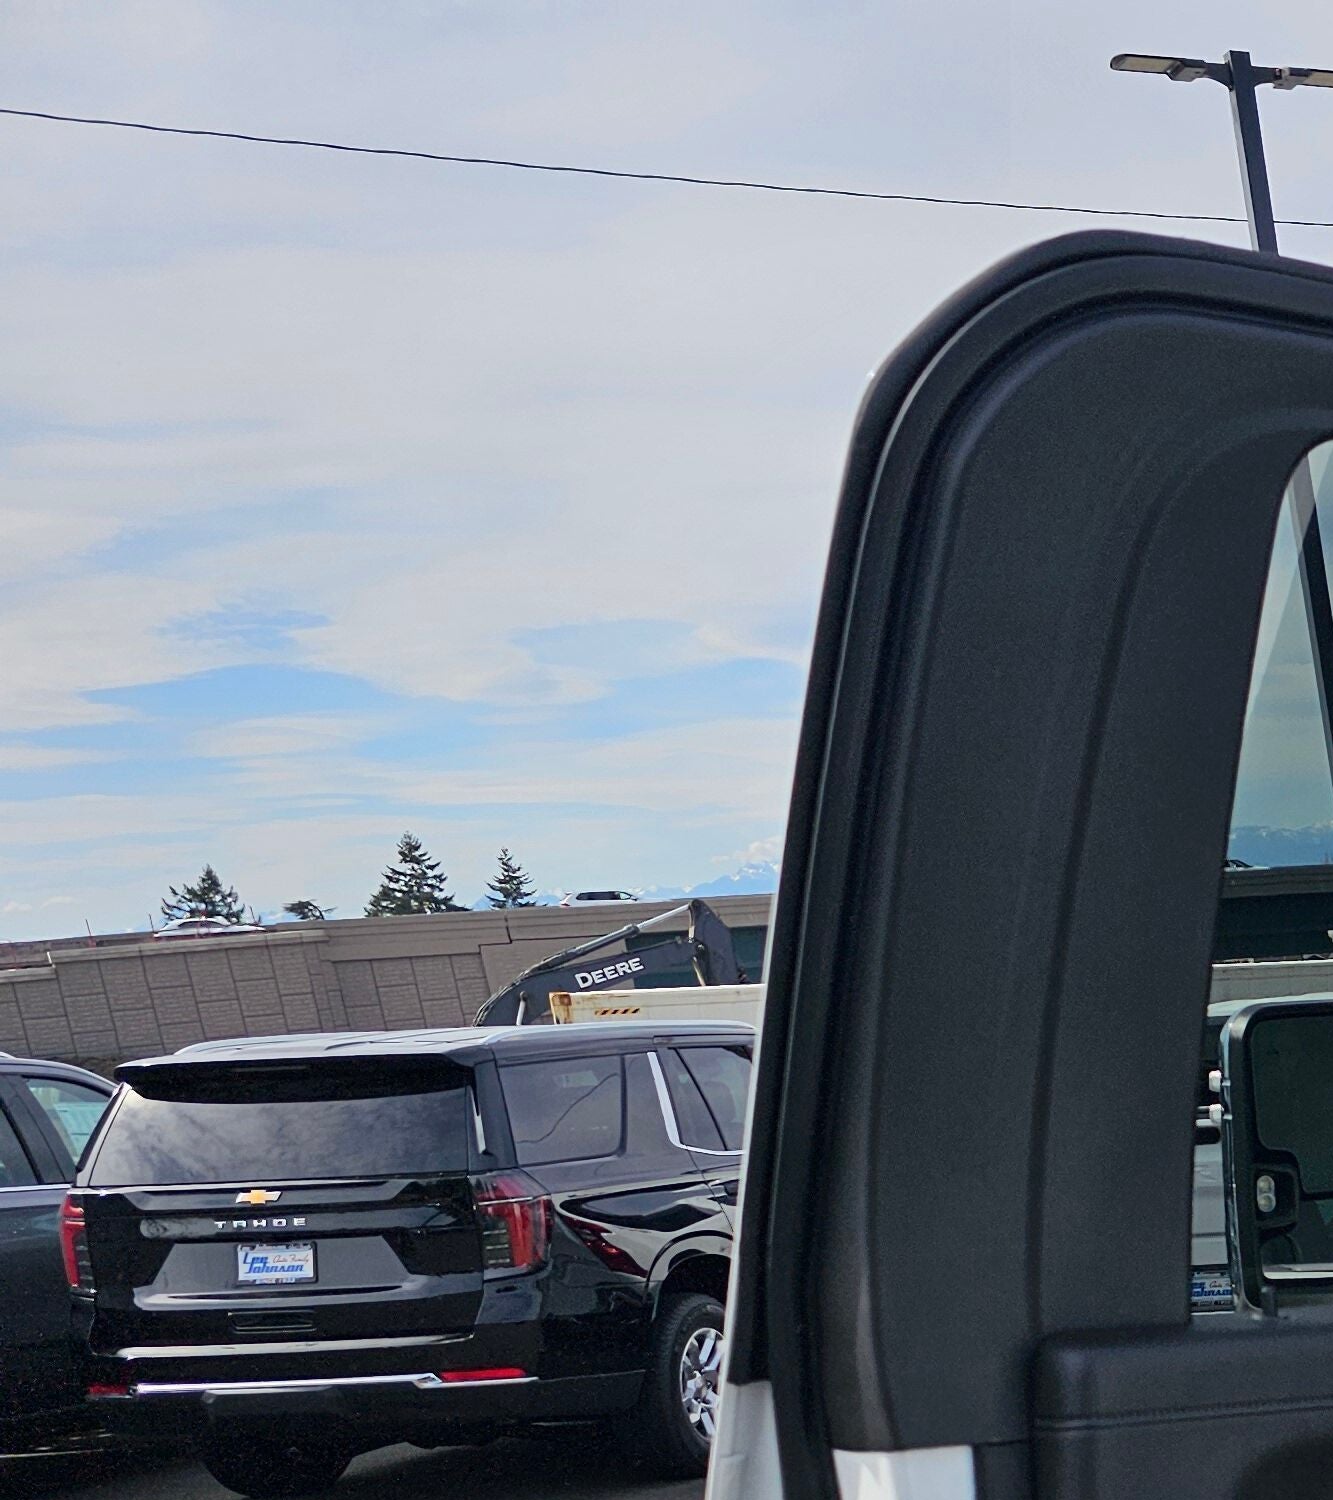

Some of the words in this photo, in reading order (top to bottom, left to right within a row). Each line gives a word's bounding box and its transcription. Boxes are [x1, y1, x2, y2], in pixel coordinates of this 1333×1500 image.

[574, 957, 644, 989] DEERE
[214, 1217, 307, 1229] TAHOE
[243, 1252, 268, 1264] Lee
[245, 1259, 304, 1274] Johnson
